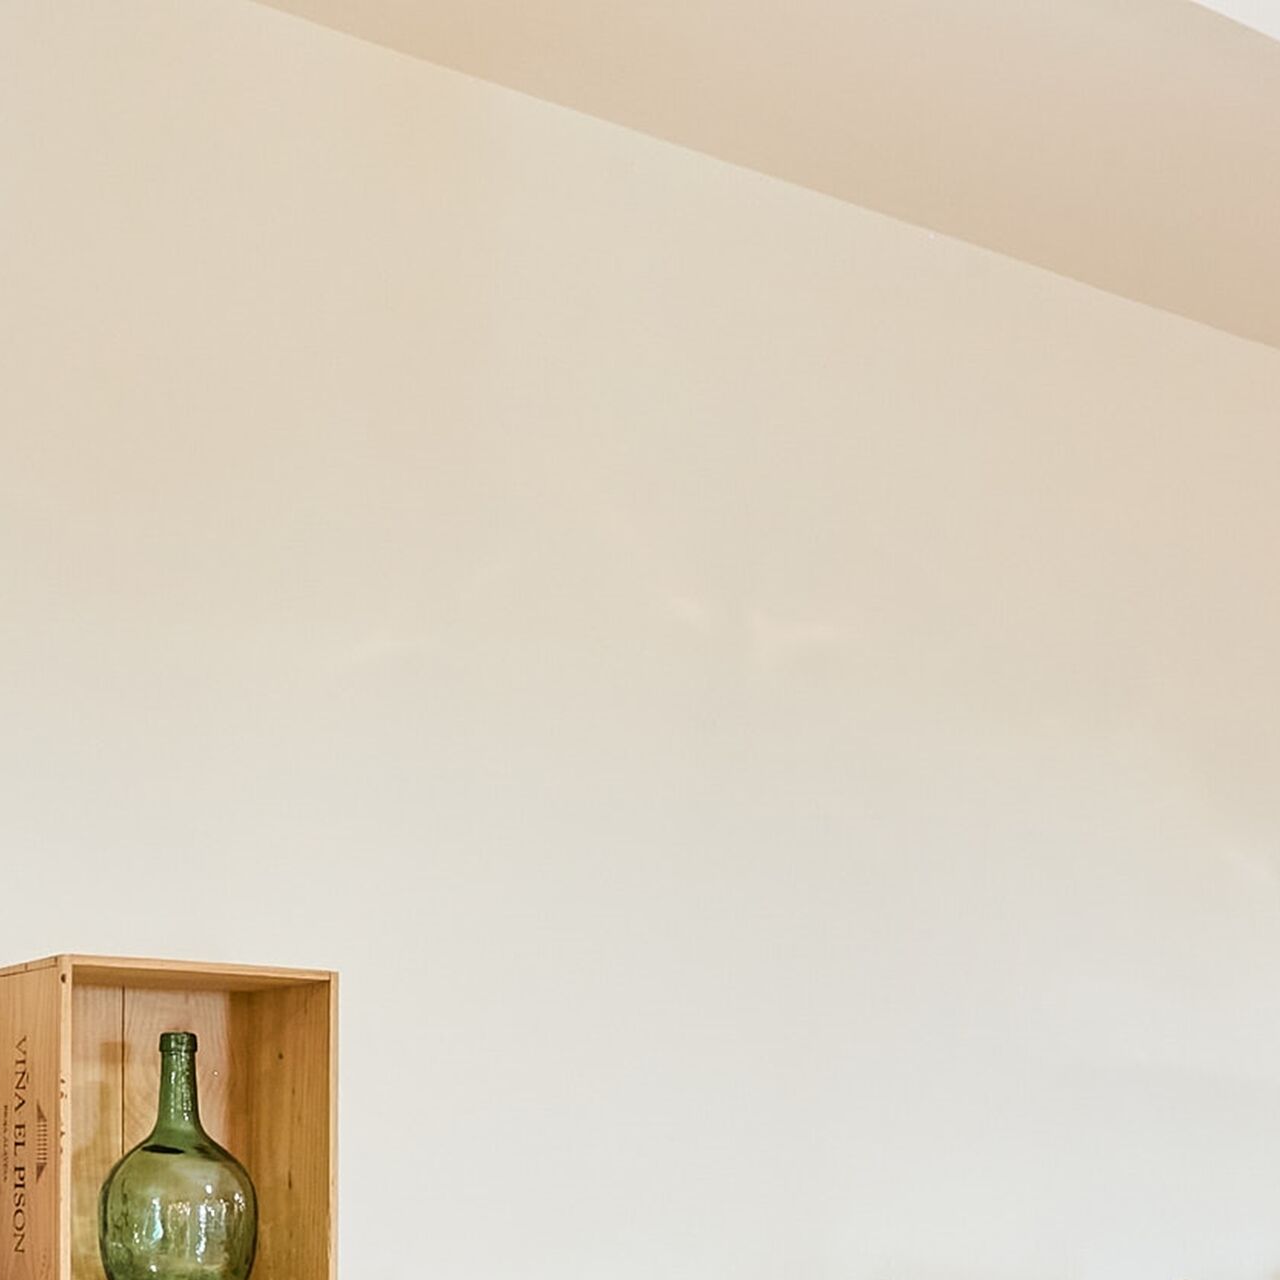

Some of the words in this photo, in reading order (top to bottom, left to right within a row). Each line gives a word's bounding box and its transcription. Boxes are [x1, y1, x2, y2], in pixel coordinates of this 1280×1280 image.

[14, 1035, 29, 1112] VIÑA
[14, 1124, 26, 1157] EL
[13, 1166, 26, 1253] PISON
